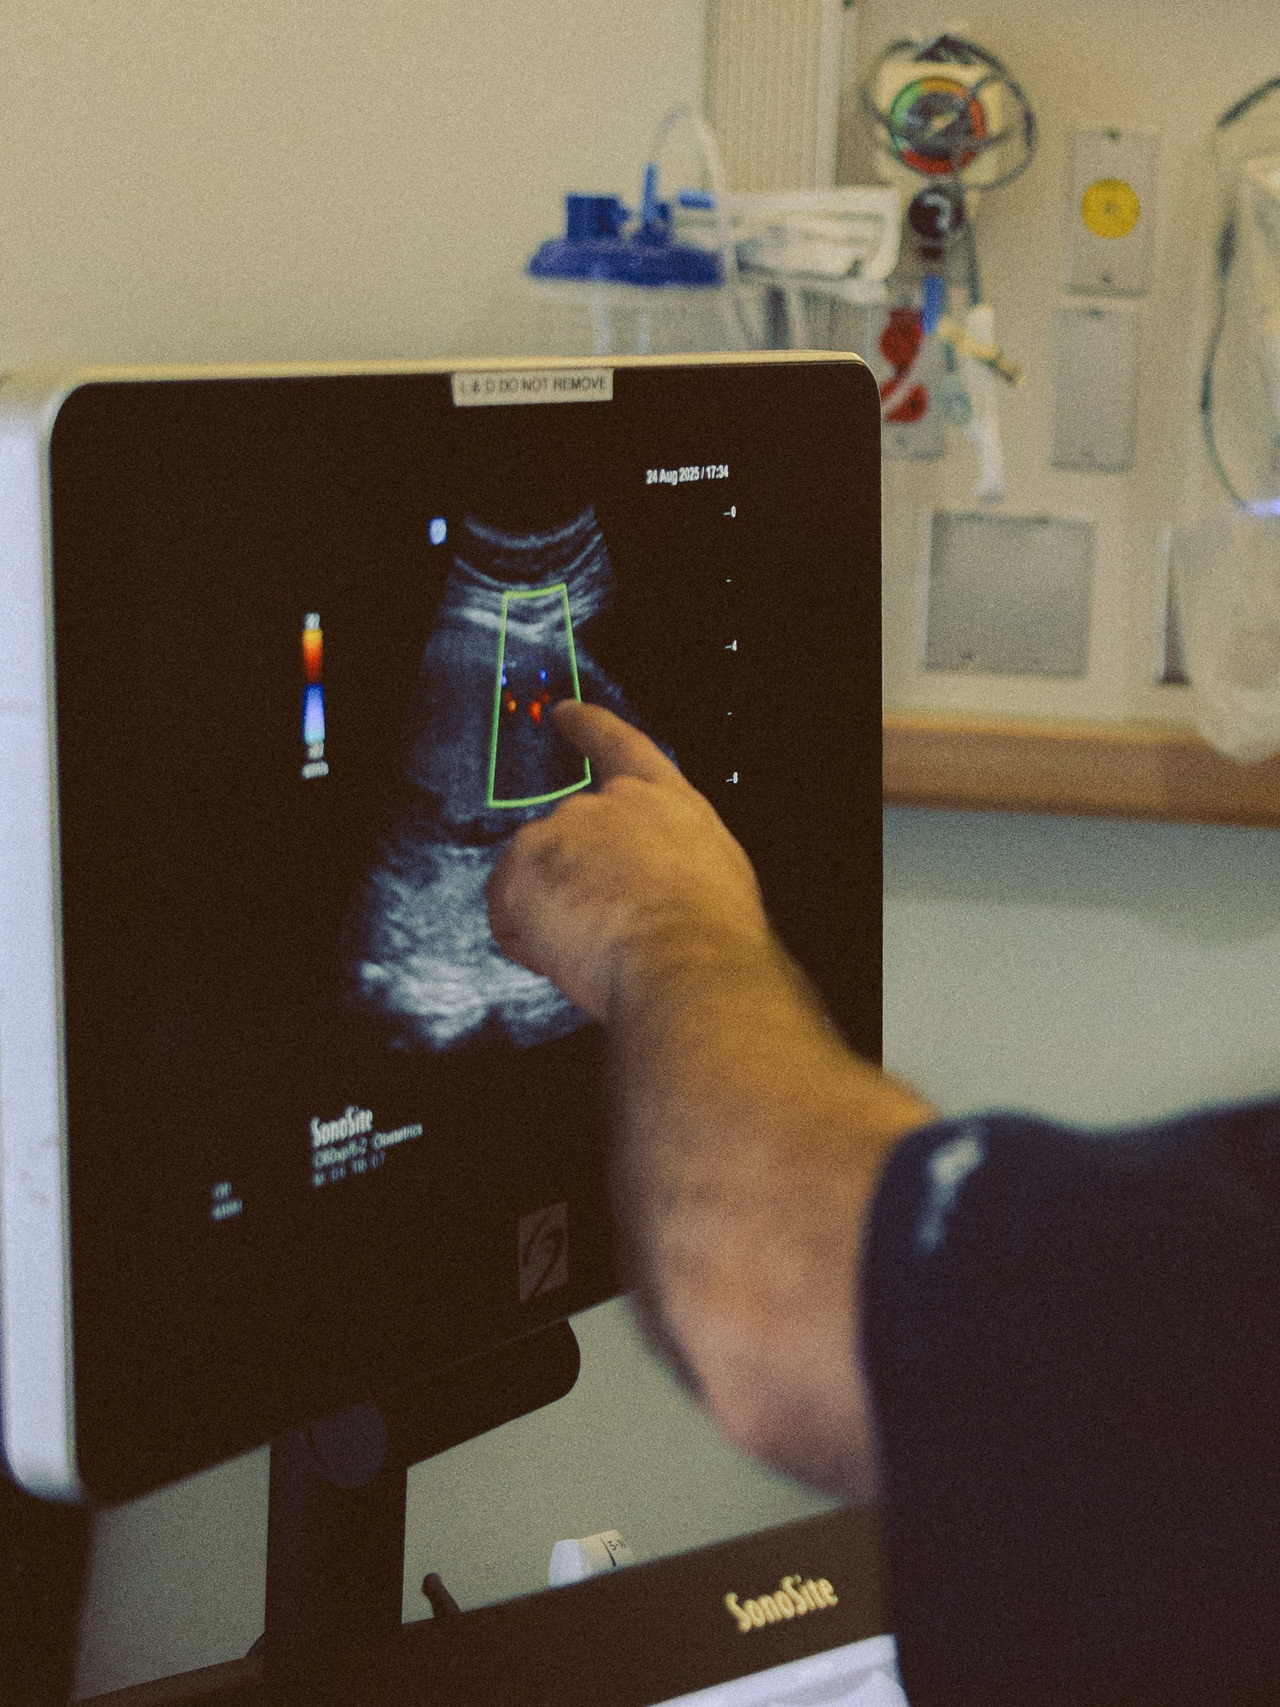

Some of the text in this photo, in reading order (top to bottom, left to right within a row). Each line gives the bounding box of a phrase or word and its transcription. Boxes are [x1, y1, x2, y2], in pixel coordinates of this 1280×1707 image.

[485, 379, 496, 394] D
[500, 378, 519, 393] DO
[521, 376, 548, 392] NOT
[553, 375, 608, 391] REMOVE
[646, 469, 658, 485] 24
[659, 468, 678, 486] Aug
[679, 466, 700, 482] 2025
[706, 465, 729, 480] 17:34
[310, 1105, 373, 1149] SonoSite
[373, 1123, 423, 1150] Obstetrics
[725, 1574, 839, 1632] SonoSite
